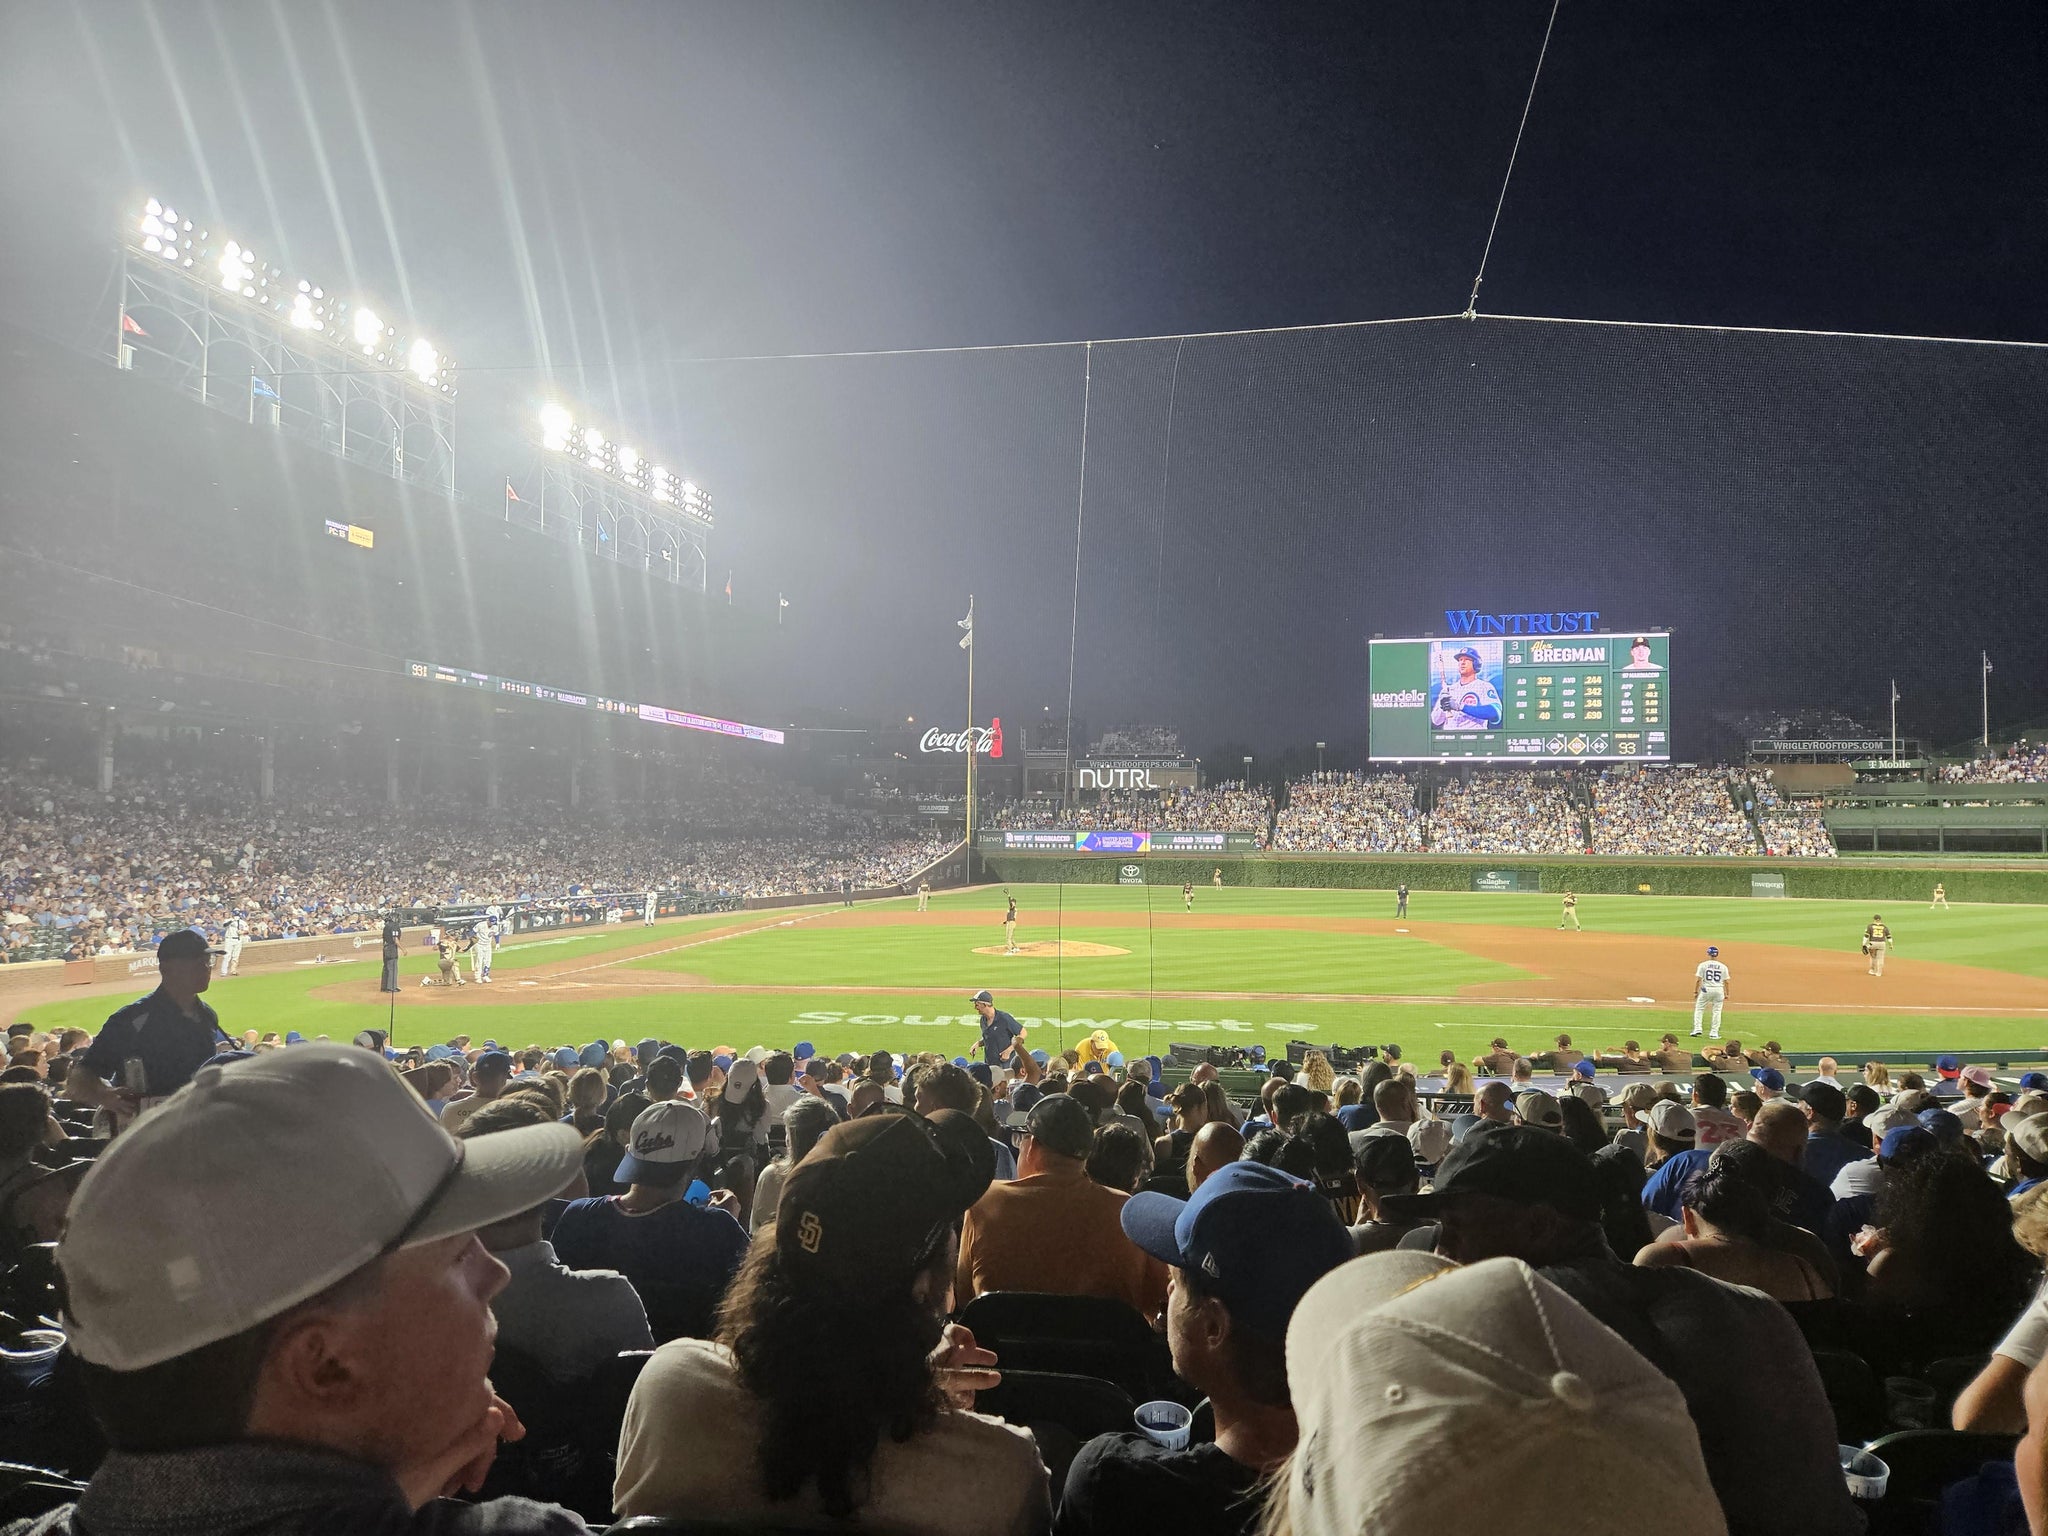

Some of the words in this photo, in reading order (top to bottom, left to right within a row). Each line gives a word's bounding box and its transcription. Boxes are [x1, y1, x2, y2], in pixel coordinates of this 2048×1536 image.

[1445, 610, 1599, 635] WINTRUST
[1511, 641, 1519, 650] 3
[1531, 640, 1553, 652] Alex
[1508, 655, 1522, 664] 3B
[1533, 647, 1605, 663] BREGMAN
[412, 664, 423, 677] 93
[1372, 690, 1427, 701] wendella
[1541, 688, 1548, 697] 7
[919, 726, 995, 753] Coca-Cla
[1618, 742, 1637, 754] 93
[1774, 741, 1883, 750] WRIGLEYROOFTOPS.COM
[1879, 760, 1911, 769] Mobile
[980, 834, 1003, 843] Harvey
[1477, 878, 1511, 886] Gallagher
[1751, 881, 1785, 889] Invenergy
[128, 957, 160, 973] MARQU
[1705, 970, 1722, 982] 65
[1697, 1121, 1740, 1143] 23
